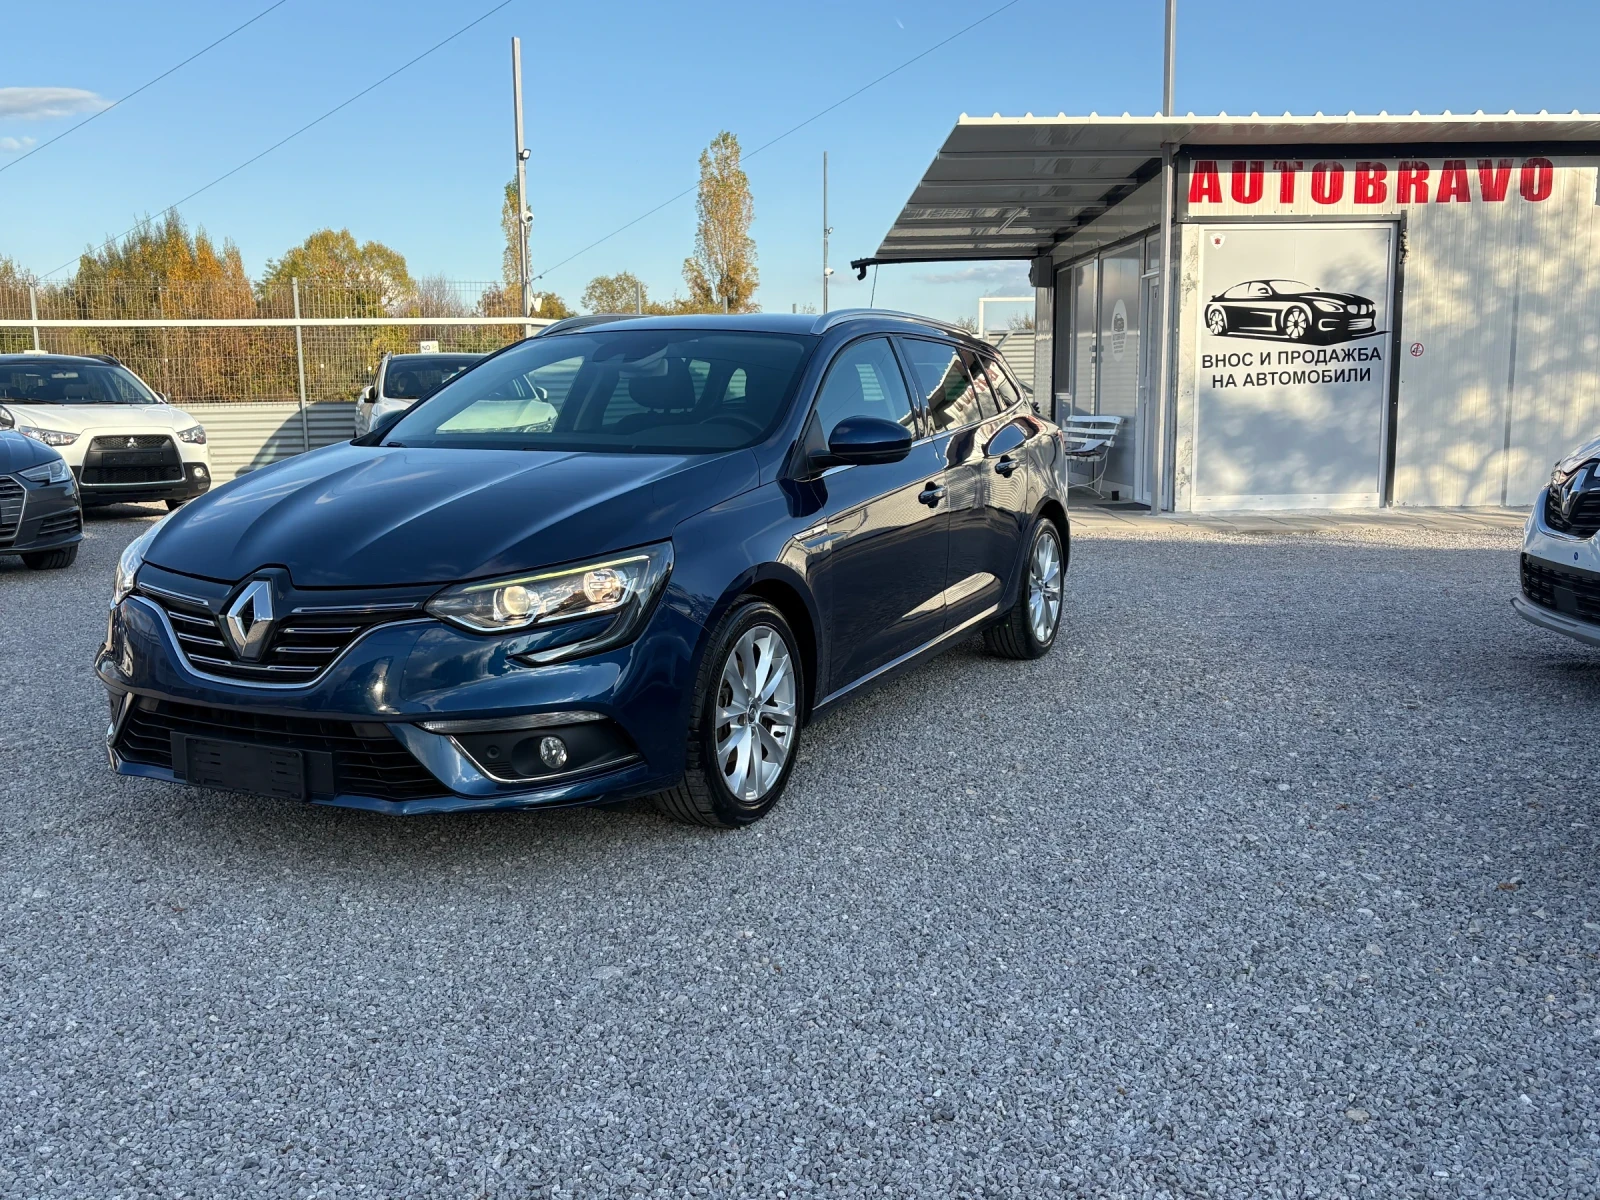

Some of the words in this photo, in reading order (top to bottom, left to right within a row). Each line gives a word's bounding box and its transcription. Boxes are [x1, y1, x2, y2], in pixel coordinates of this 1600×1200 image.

[1188, 158, 1554, 204] AUTOBRAVO
[1202, 353, 1253, 369] ВНОС
[1260, 352, 1271, 366] И
[1278, 347, 1382, 366] ПРОДАЖБА
[1212, 374, 1238, 389] НА
[1243, 368, 1371, 388] АВТОМОБИЛИ
